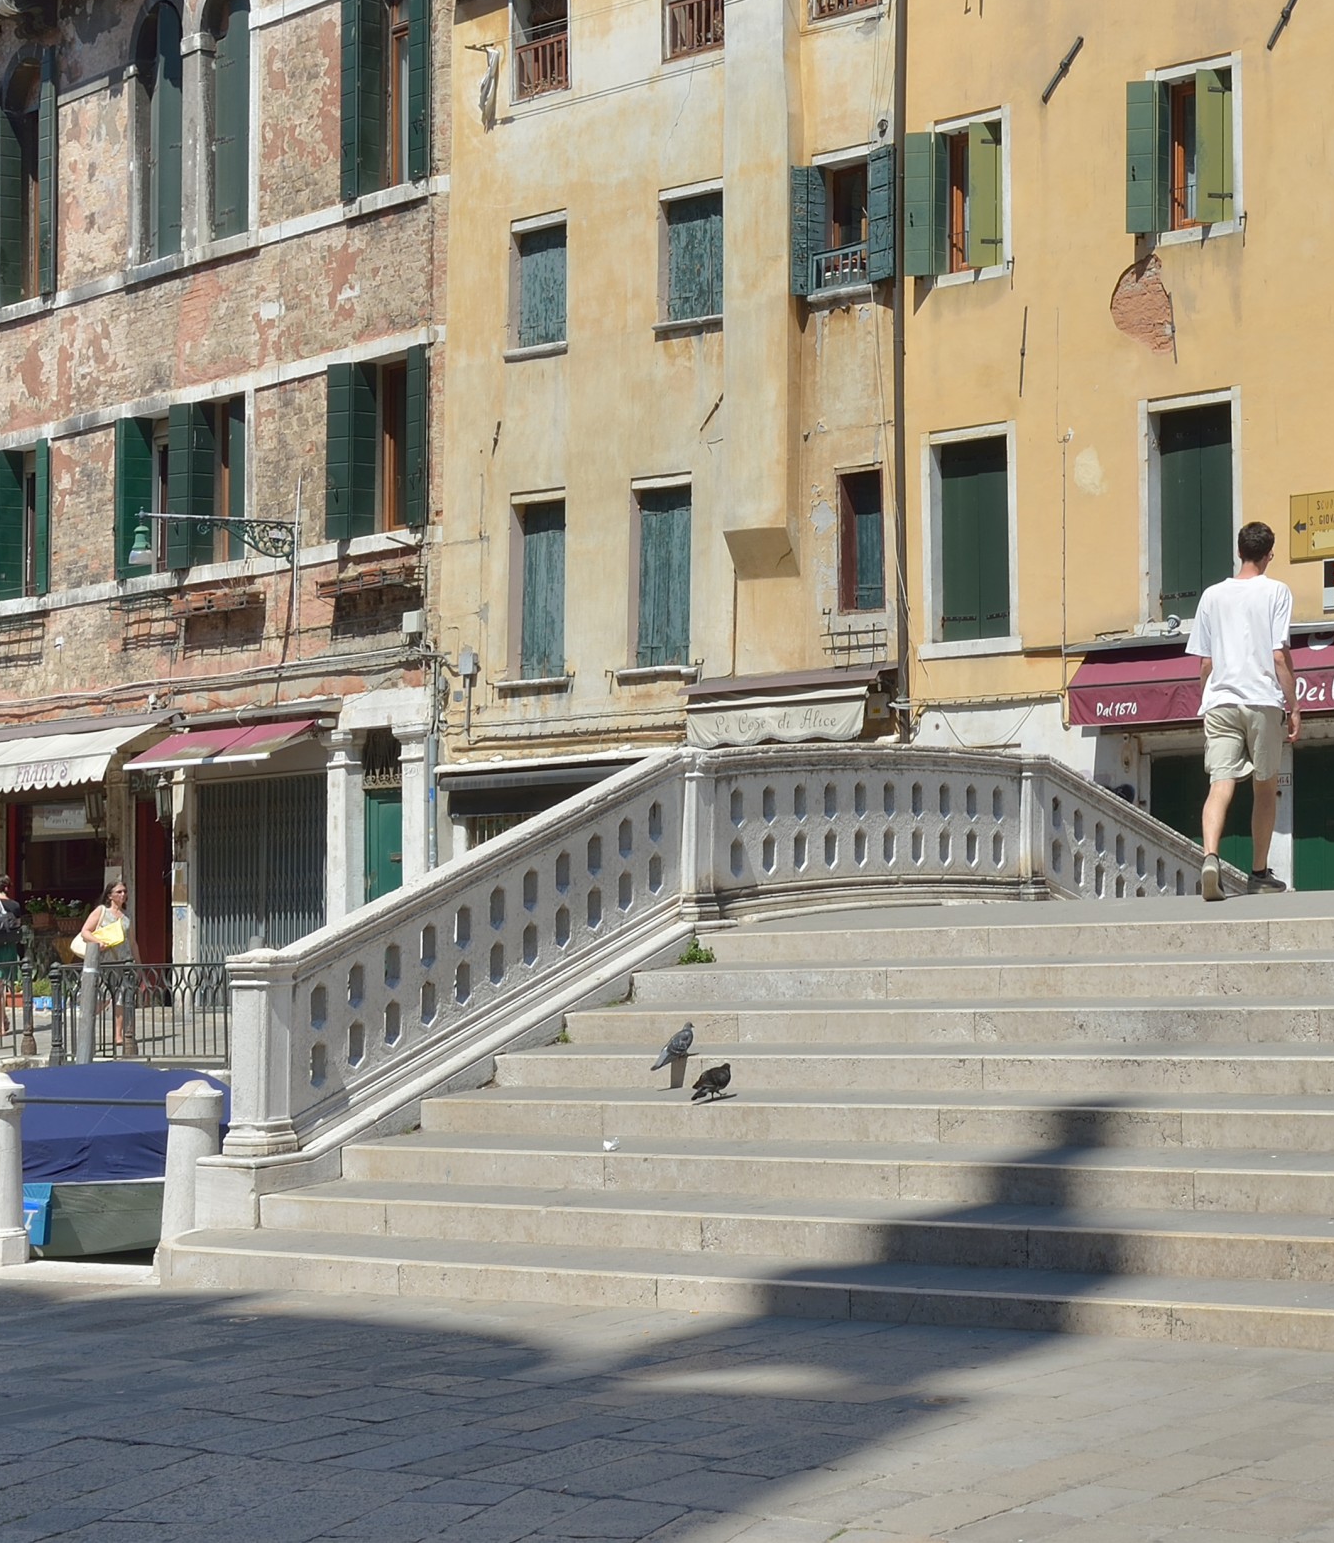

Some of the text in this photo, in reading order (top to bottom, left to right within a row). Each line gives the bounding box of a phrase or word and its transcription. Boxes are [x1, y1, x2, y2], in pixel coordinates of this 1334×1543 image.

[1295, 676, 1326, 702] Dei
[738, 712, 767, 734] Cose
[777, 711, 790, 730] di
[799, 707, 837, 730] Alice
[1096, 701, 1137, 717] Dal 1870
